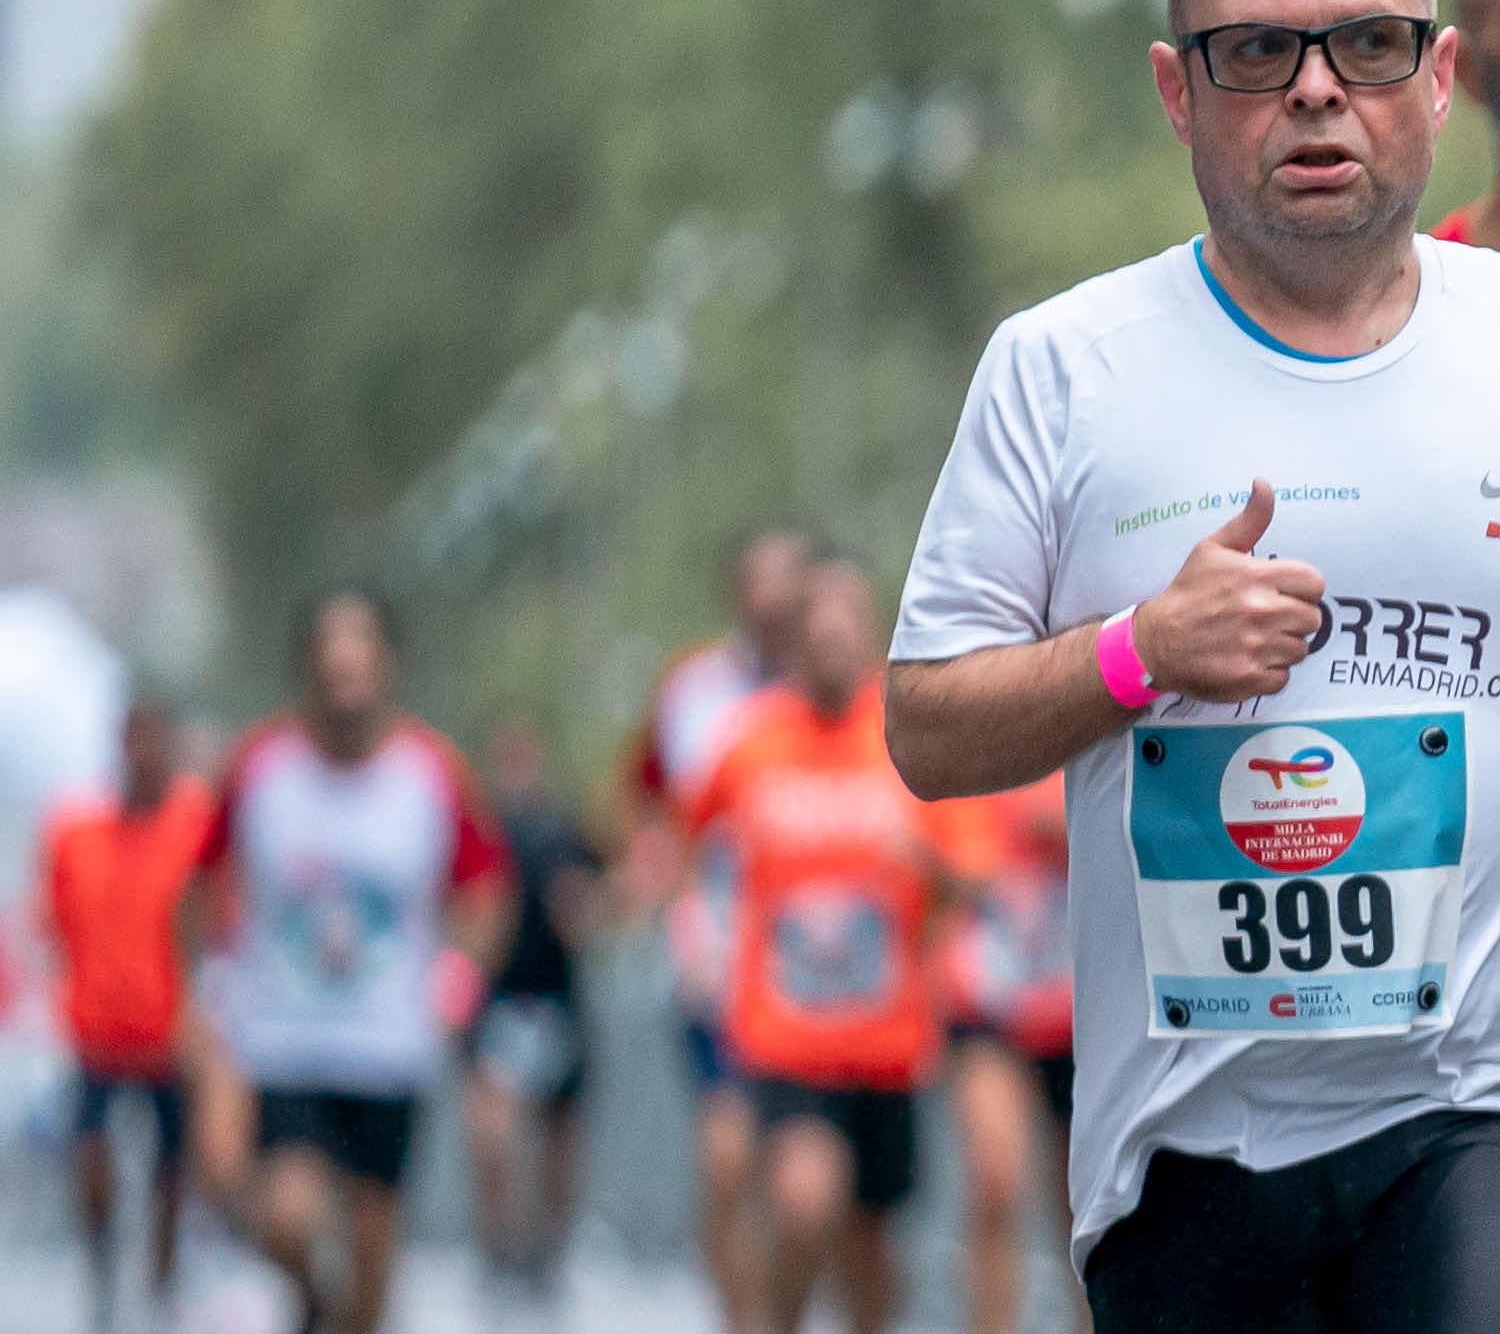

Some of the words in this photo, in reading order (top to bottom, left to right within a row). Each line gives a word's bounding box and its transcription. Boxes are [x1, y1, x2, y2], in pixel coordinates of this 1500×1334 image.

[1114, 499, 1192, 536] instituto
[1199, 492, 1221, 511] de
[1228, 483, 1361, 508] varaciones
[1251, 796, 1338, 811] TotalEnergies
[1273, 823, 1315, 835] MILLA
[1261, 850, 1278, 862] DE
[1280, 847, 1333, 860] MADRID
[1218, 873, 1395, 974] 399
[1184, 998, 1251, 1013] MADRID
[1298, 993, 1343, 1005] MILLA
